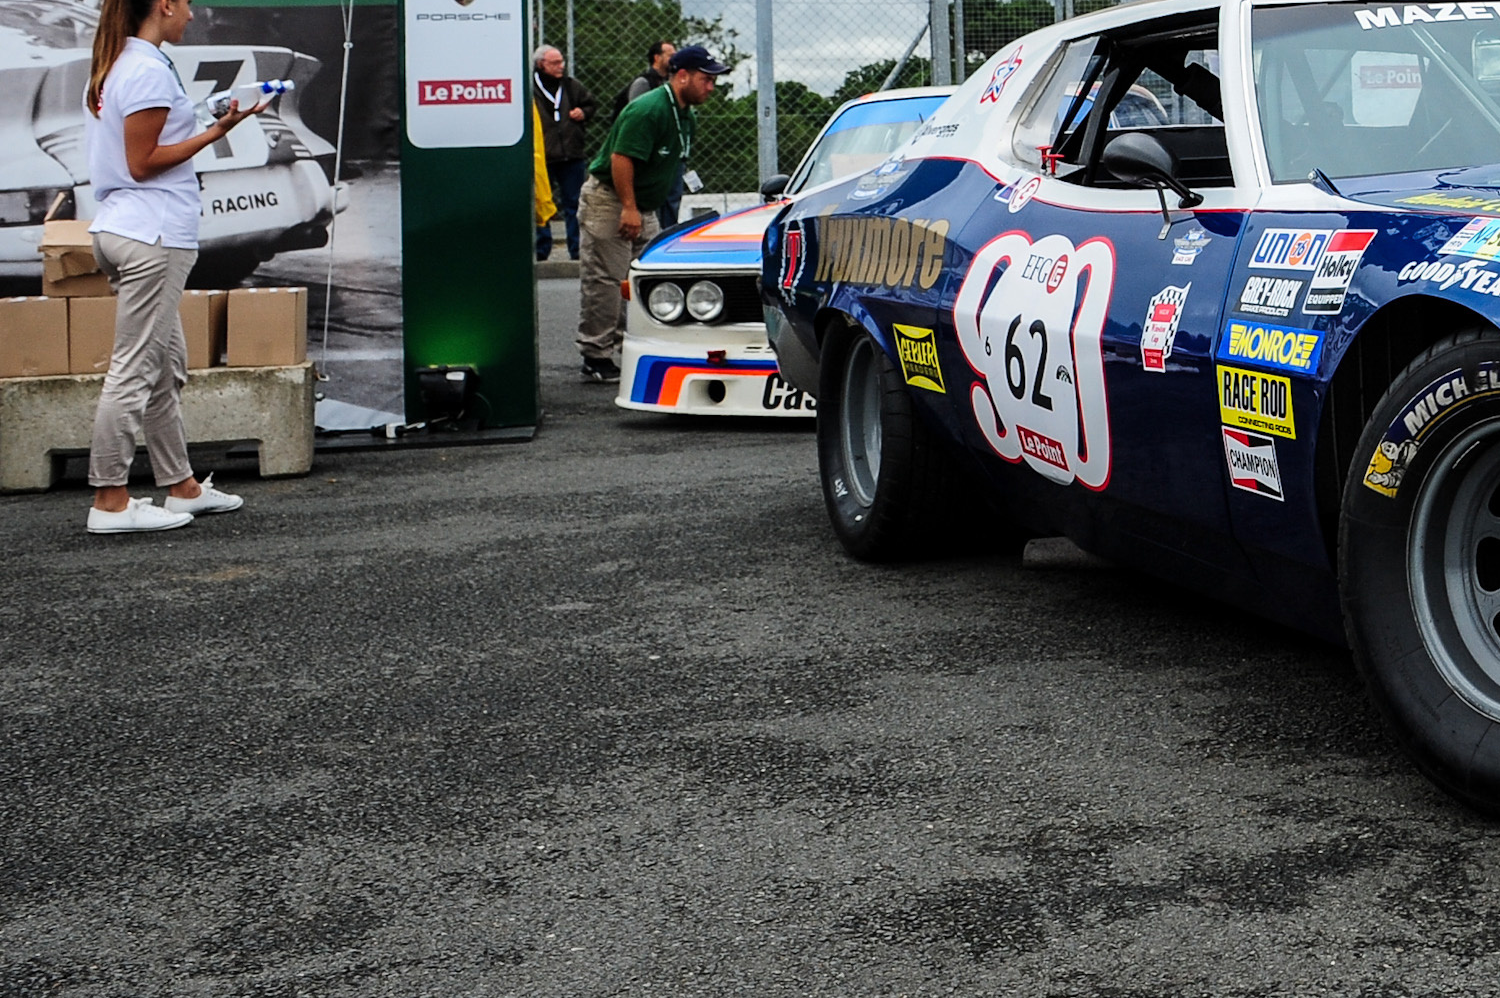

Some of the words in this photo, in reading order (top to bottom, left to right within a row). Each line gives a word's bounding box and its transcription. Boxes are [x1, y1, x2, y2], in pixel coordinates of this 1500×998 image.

[416, 13, 511, 21] PORSCHE
[424, 85, 448, 101] Le
[451, 81, 506, 101] Point
[1366, 67, 1385, 85] Le
[1386, 67, 1421, 85] Poin
[212, 192, 278, 215] RACING
[814, 205, 949, 290] Truxmore
[1254, 233, 1327, 266] UNION
[1291, 237, 1312, 257] 76
[1021, 254, 1053, 284] EFG
[1318, 254, 1357, 284] Holley
[1240, 276, 1303, 309] GREY-ROCK
[1308, 293, 1345, 306] EQUIPPED
[984, 336, 992, 356] 6
[1229, 323, 1319, 369] MONROE
[1005, 313, 1053, 411] 62
[1223, 371, 1257, 413] RACE
[1259, 378, 1287, 421] ROD
[1238, 416, 1275, 430] CONNECTING
[1275, 423, 1292, 435] RODS
[1020, 431, 1034, 450] Le
[1033, 436, 1064, 467] Point
[1229, 448, 1276, 479] CHAMPION
